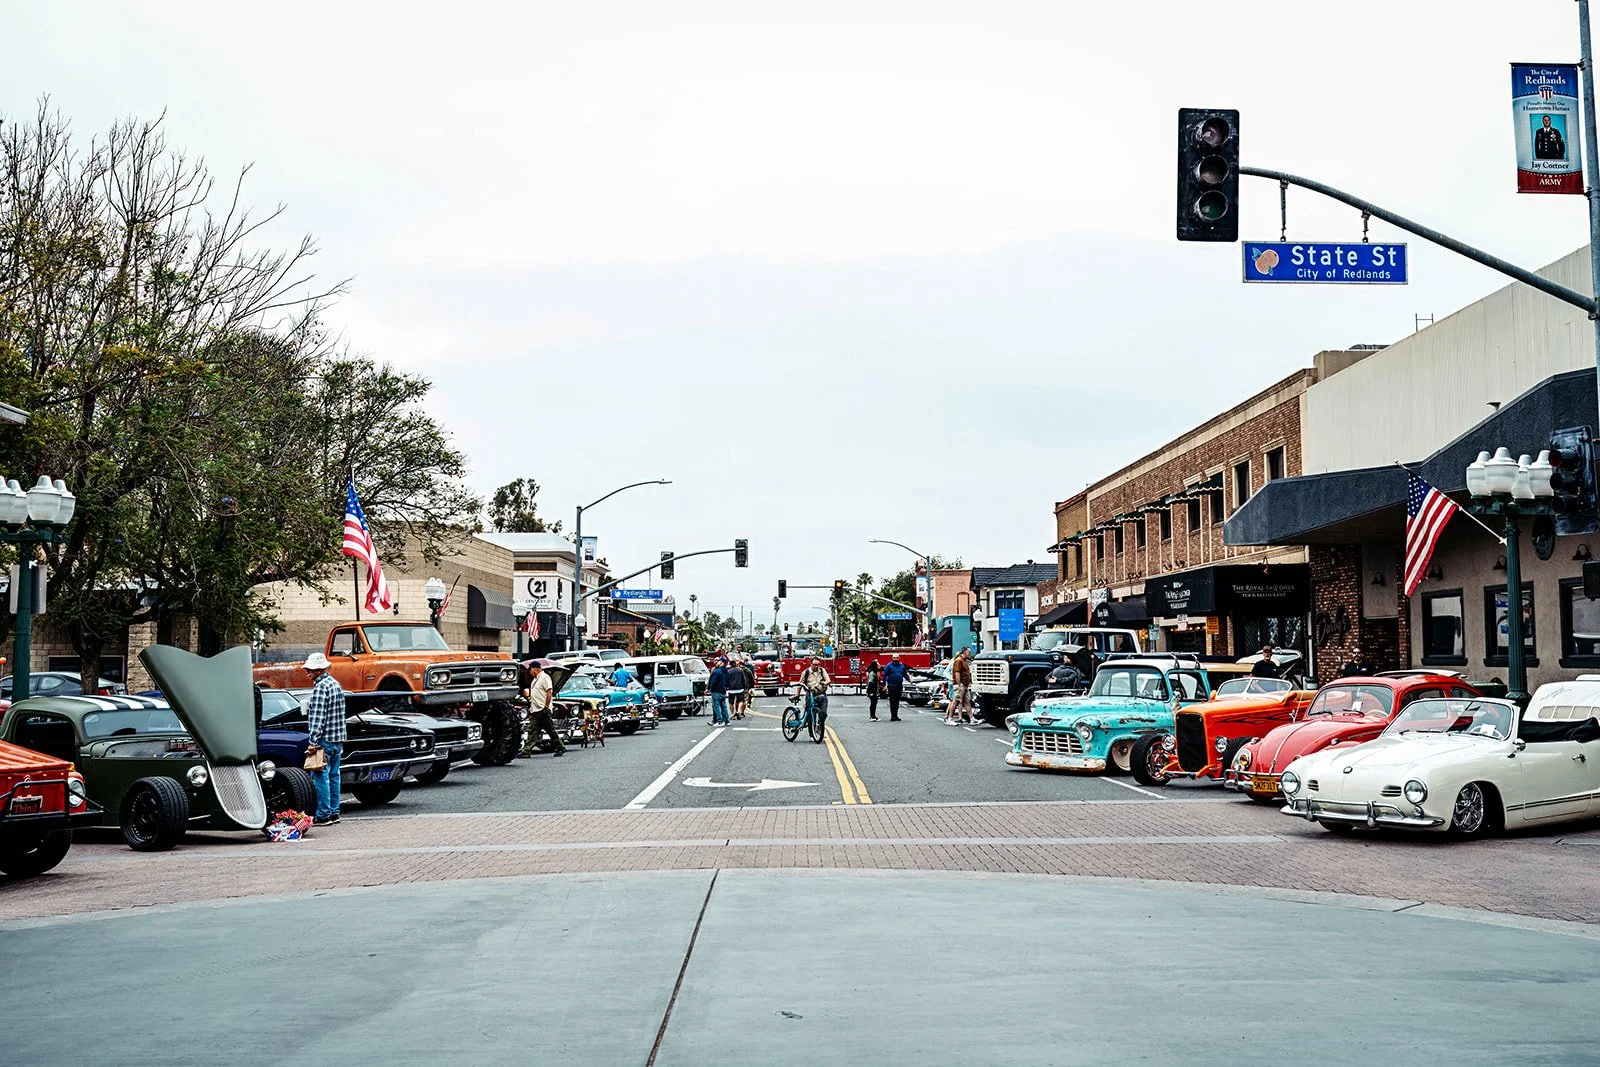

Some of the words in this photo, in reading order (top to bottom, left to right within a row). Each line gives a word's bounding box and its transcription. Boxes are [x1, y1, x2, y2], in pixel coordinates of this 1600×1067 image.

[1525, 75, 1567, 85] Redlands
[1530, 161, 1541, 171] Jay
[1542, 161, 1570, 169] Cortner
[1539, 178, 1562, 186] ARMY
[1290, 245, 1358, 266] State
[1371, 246, 1397, 267] St
[1296, 268, 1319, 280] City
[1326, 269, 1337, 278] of
[1343, 269, 1391, 279] Redlands
